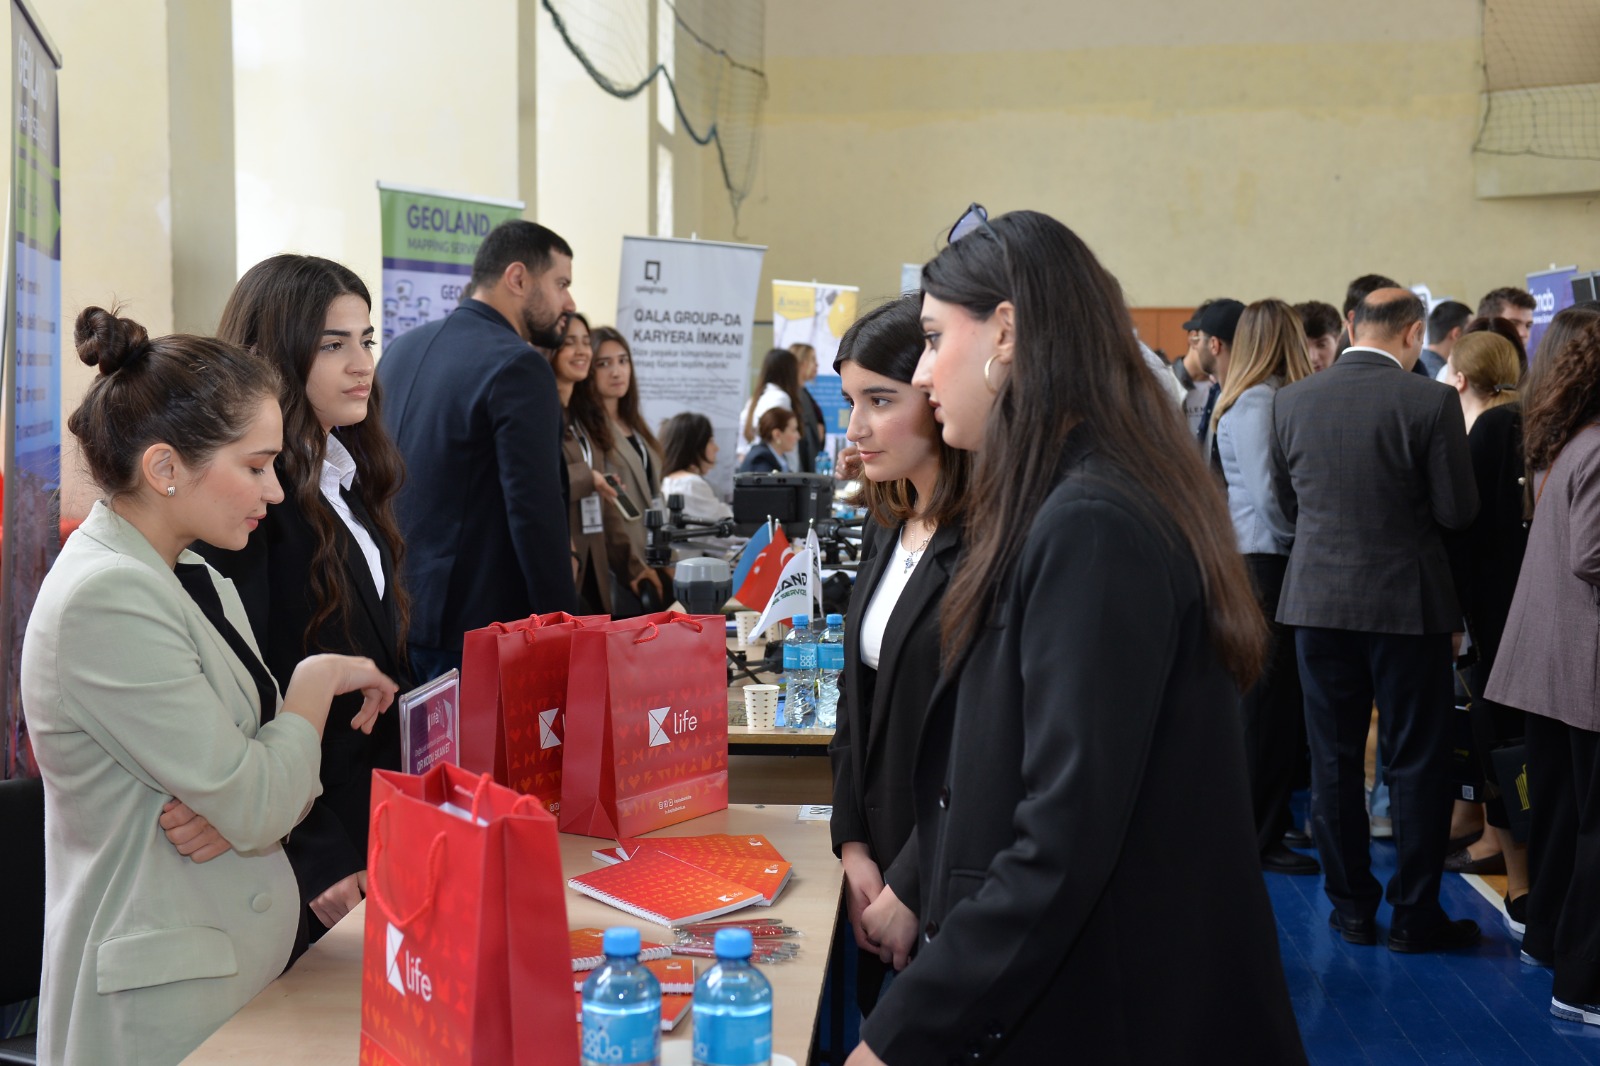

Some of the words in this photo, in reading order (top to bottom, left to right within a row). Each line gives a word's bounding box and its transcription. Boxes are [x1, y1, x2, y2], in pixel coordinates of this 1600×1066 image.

[407, 204, 490, 237] GEOLAND
[634, 309, 671, 323] QALA
[674, 310, 742, 326] GROUP-DA
[633, 329, 694, 344] KARYERA
[696, 327, 744, 346] İMKANI
[674, 709, 698, 734] life
[406, 949, 432, 1002] life
